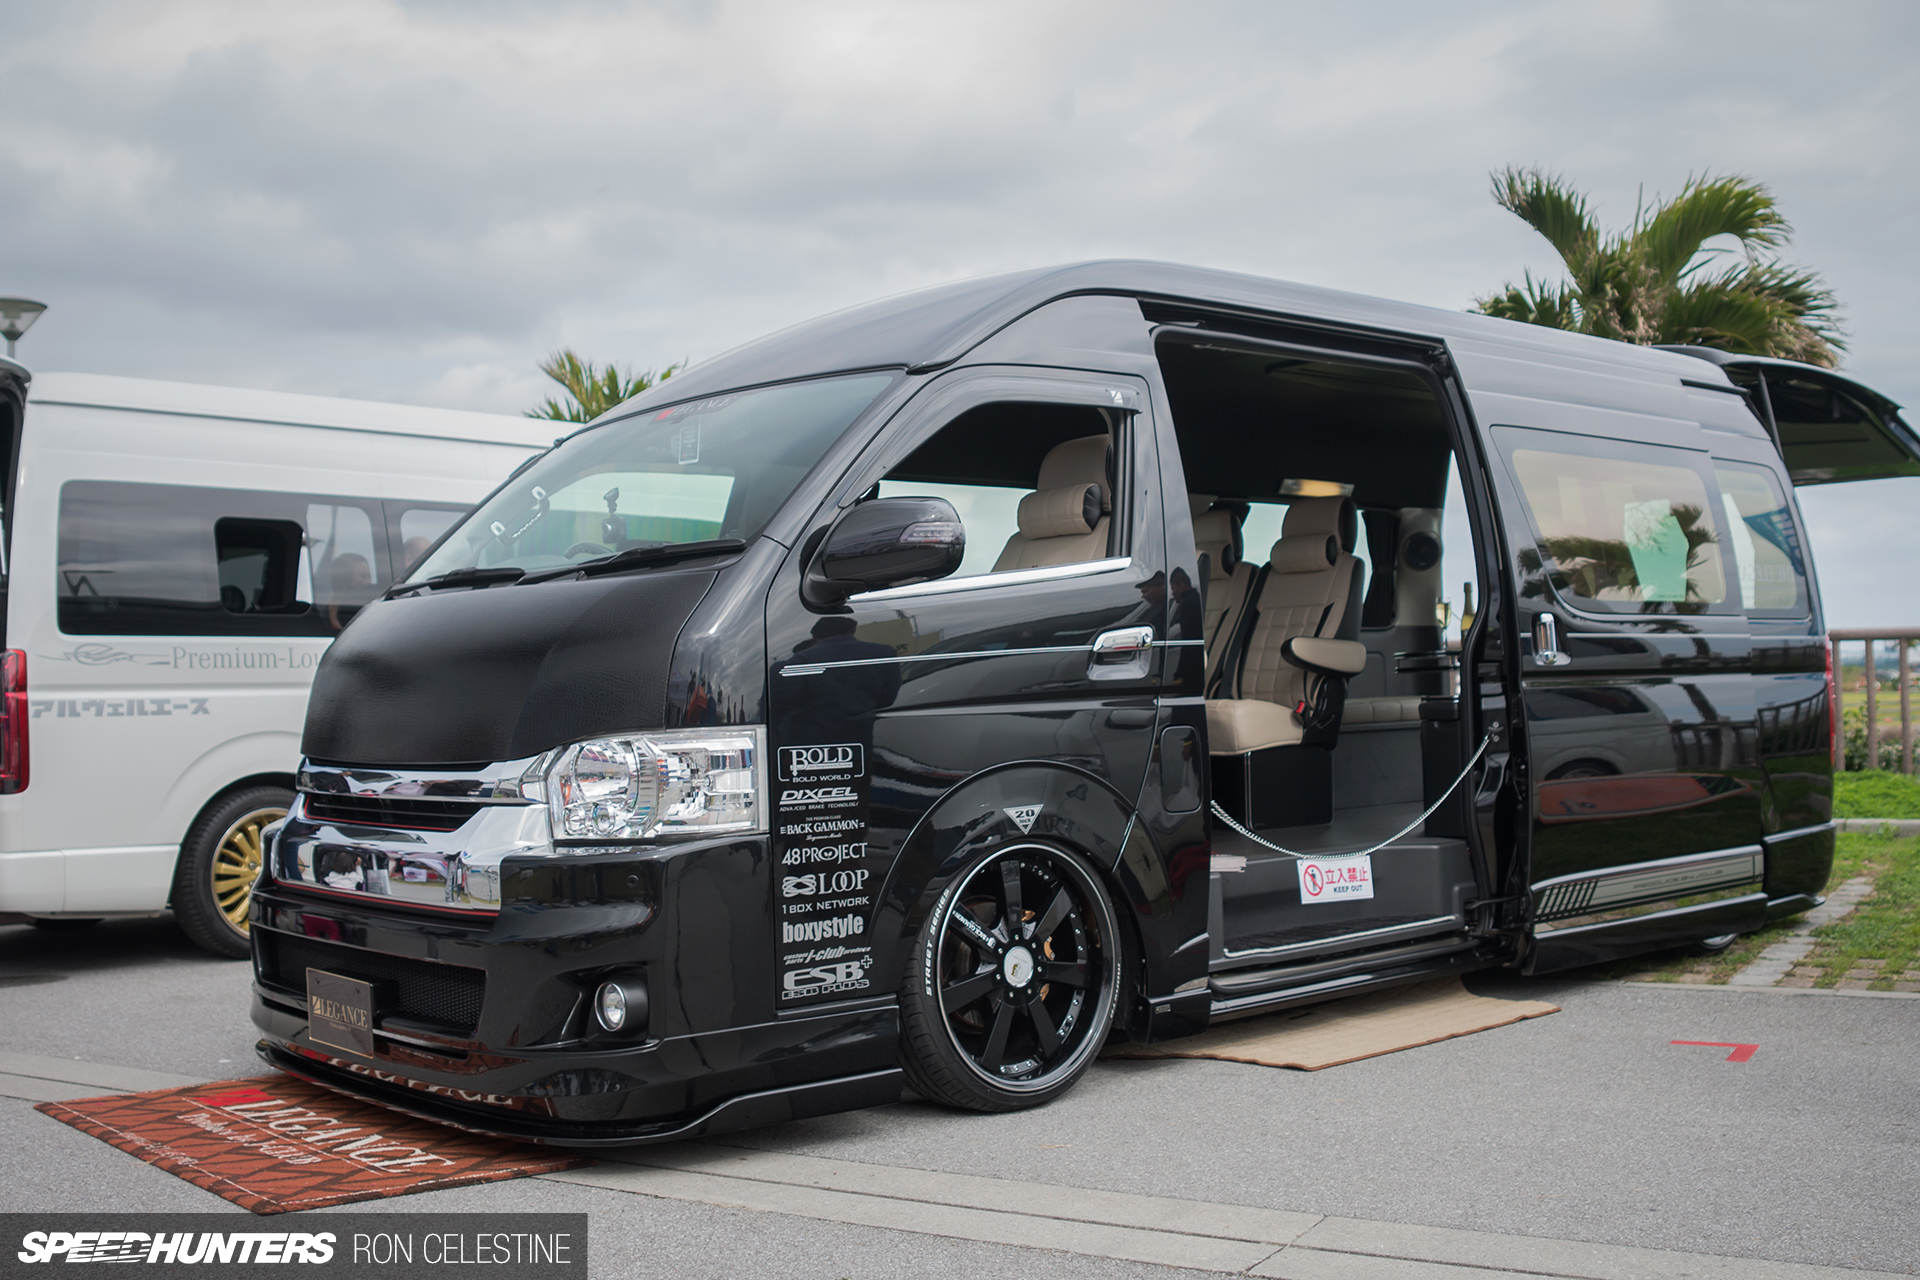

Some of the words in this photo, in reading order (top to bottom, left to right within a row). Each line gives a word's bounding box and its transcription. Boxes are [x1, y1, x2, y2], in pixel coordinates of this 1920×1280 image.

[31, 698, 210, 718] アルヴェルエース
[789, 747, 853, 774] BOLD
[792, 775, 817, 783] BOLD
[780, 787, 858, 801] DIXCEL
[1015, 809, 1035, 819] 20
[787, 823, 813, 835] BACK
[813, 819, 859, 833] GAMMON
[818, 869, 870, 895] LOOP
[1325, 866, 1369, 885] 立入禁止
[782, 904, 787, 914] 1
[789, 903, 813, 914] BOX
[816, 895, 870, 911] NETWORK
[782, 913, 864, 944] boxystyle
[924, 939, 933, 996] STREET
[929, 888, 950, 936] SERIES
[821, 979, 870, 994] PLUS
